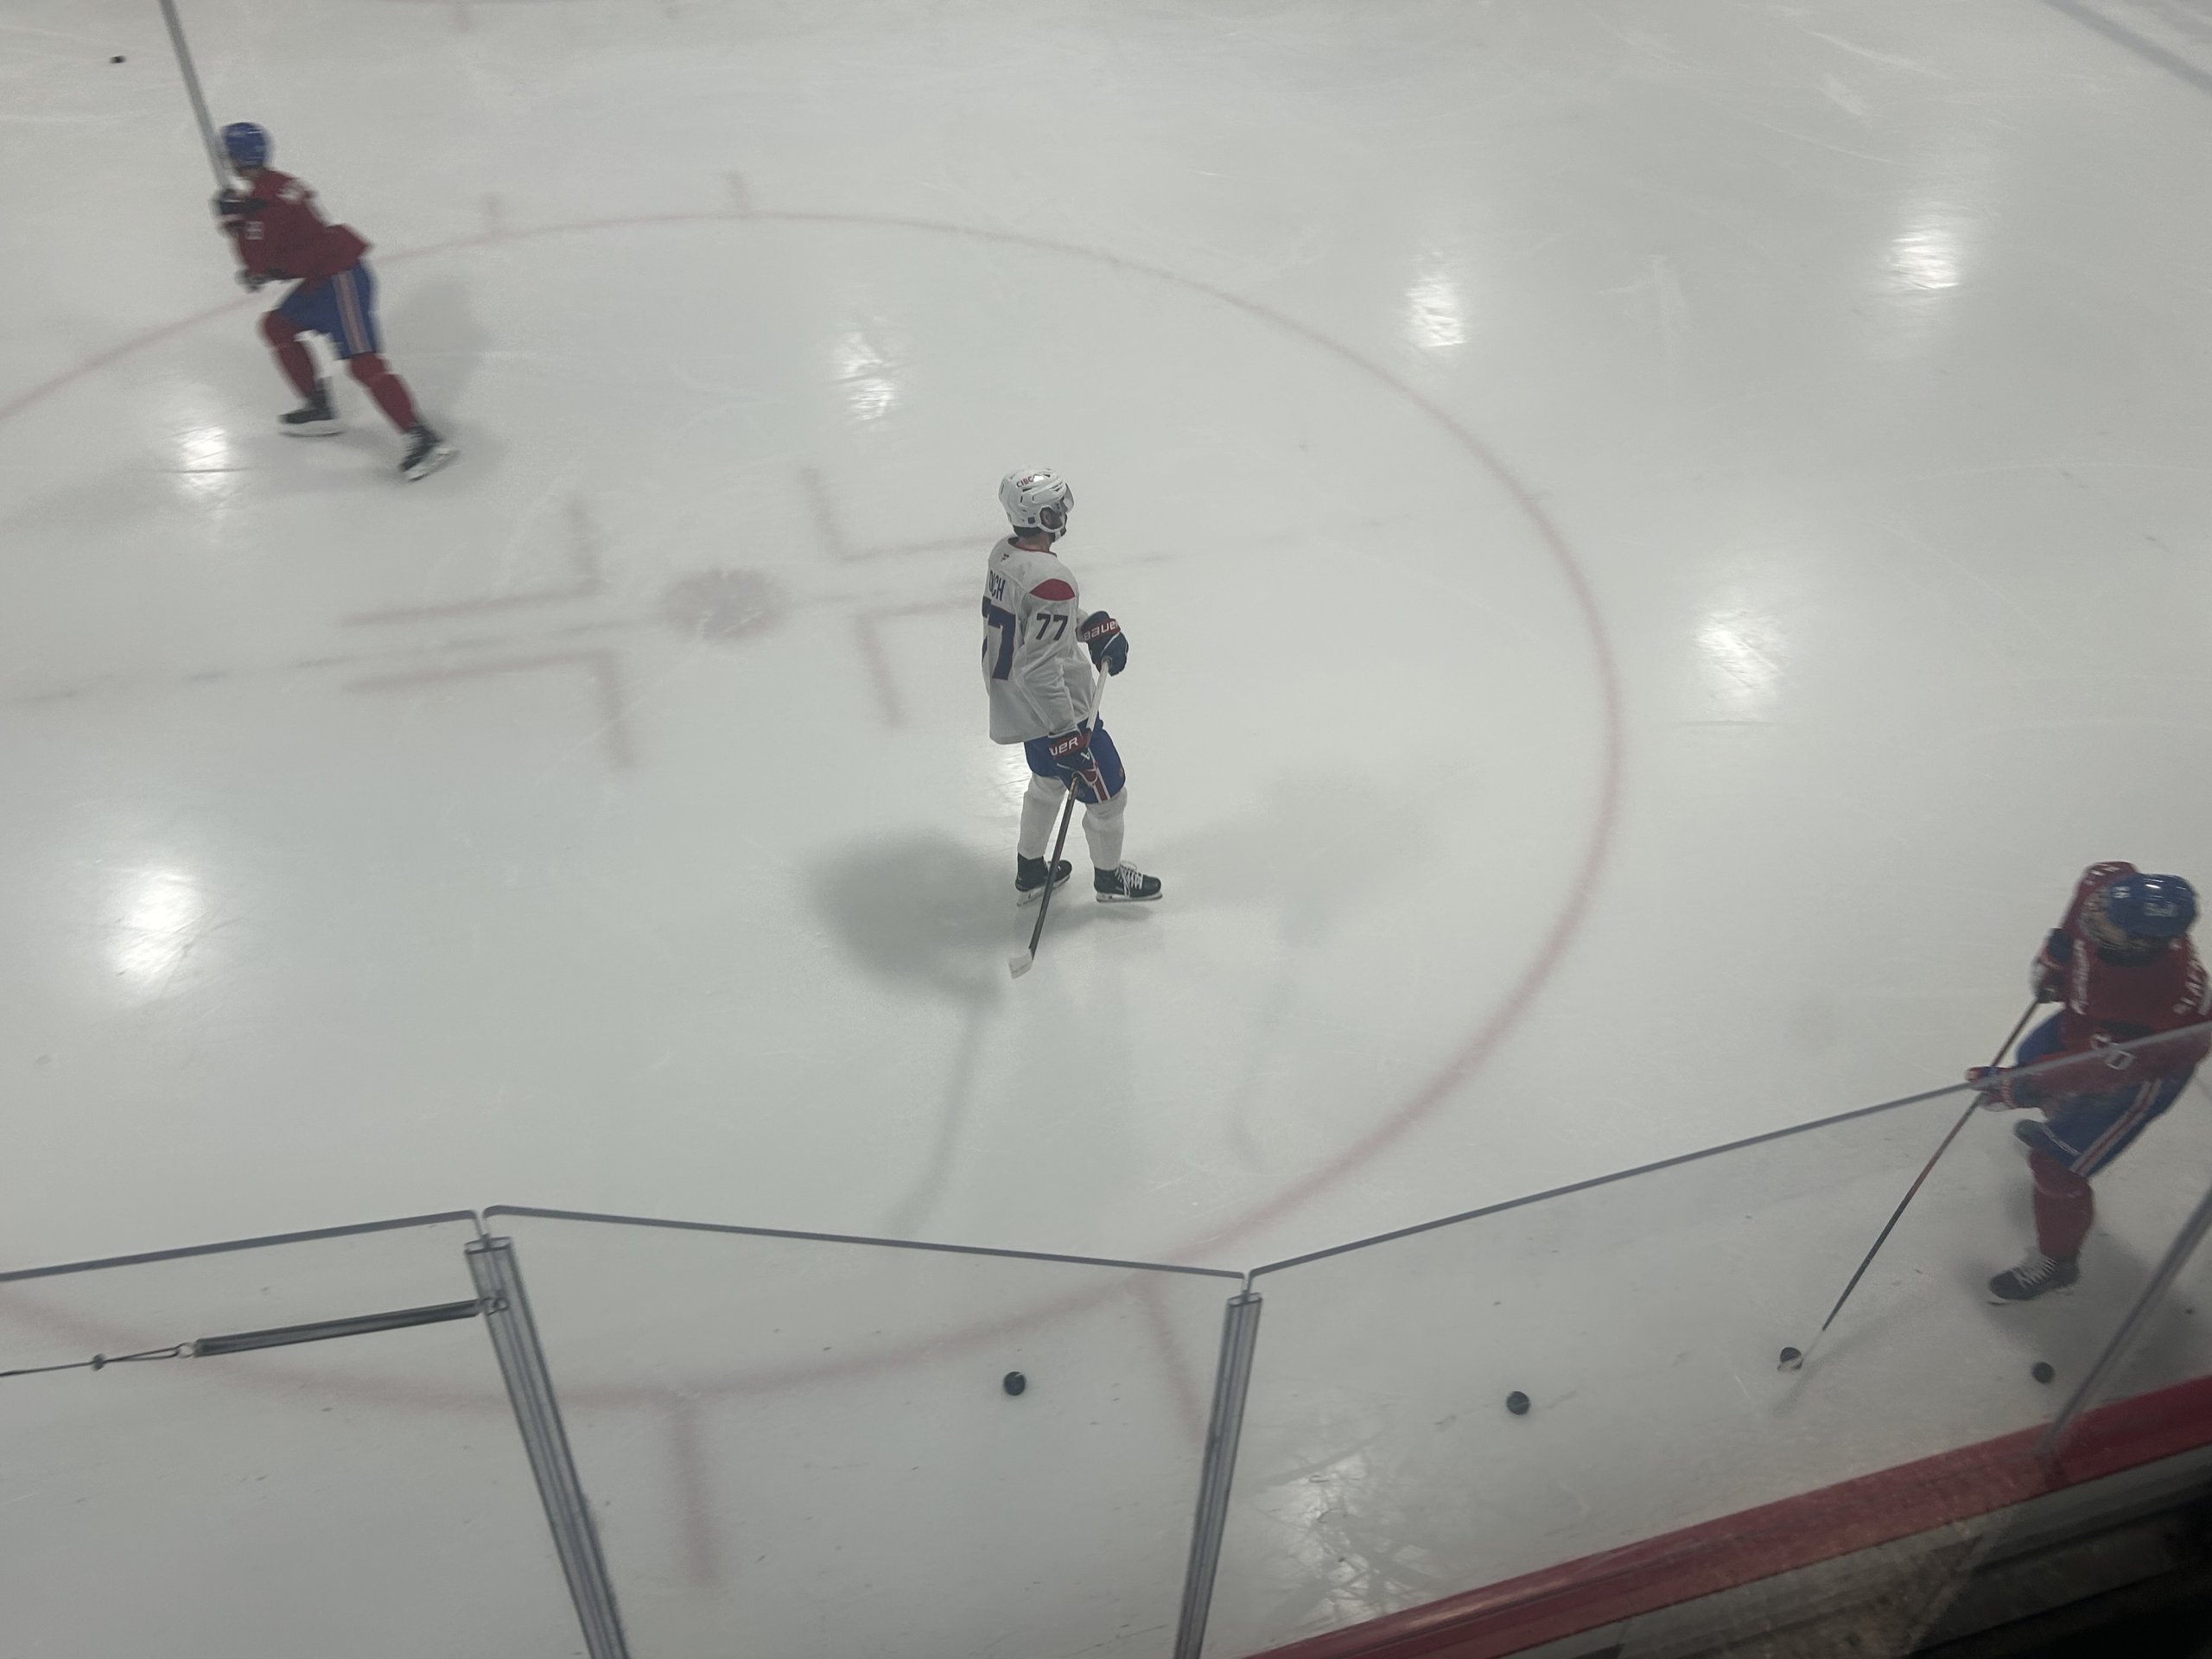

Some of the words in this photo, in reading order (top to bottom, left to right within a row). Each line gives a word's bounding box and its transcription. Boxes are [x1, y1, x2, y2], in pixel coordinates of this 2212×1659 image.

[1016, 475, 1033, 487] CIBC
[1036, 613, 1068, 641] 77
[1049, 736, 1078, 756] UER
